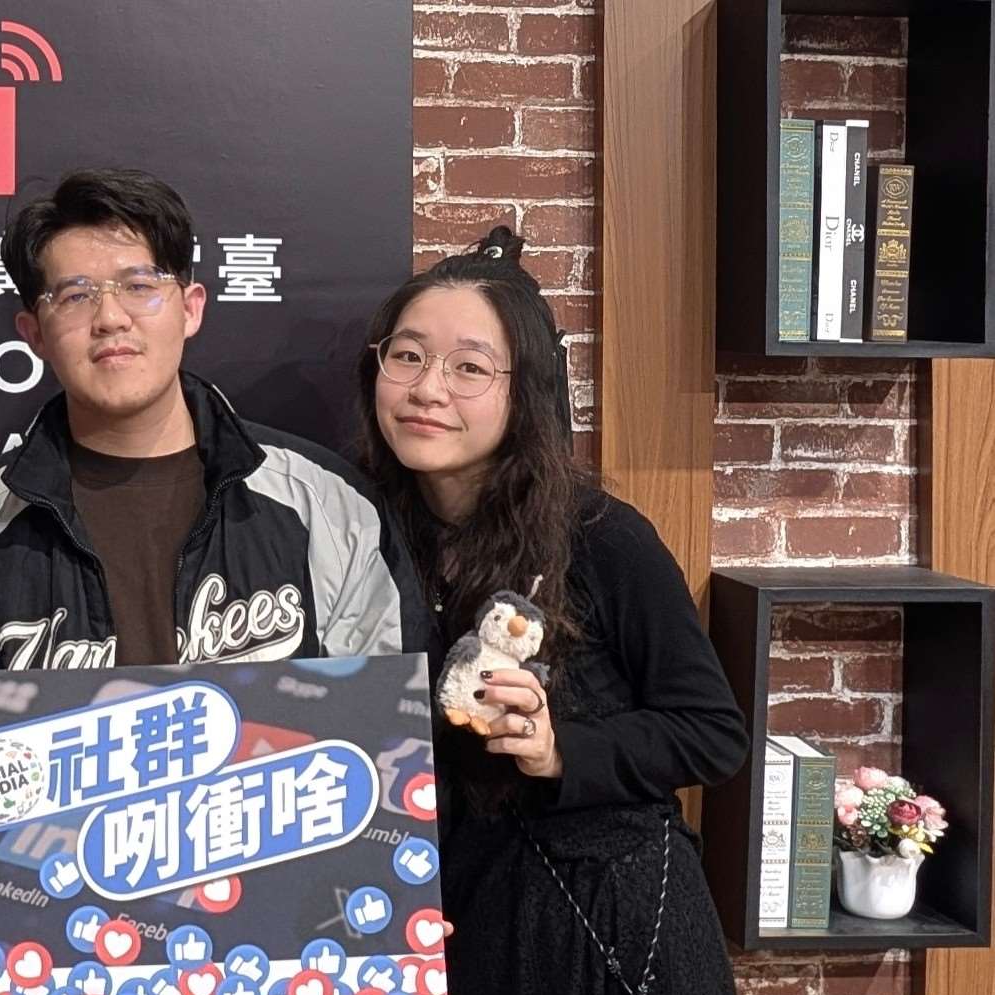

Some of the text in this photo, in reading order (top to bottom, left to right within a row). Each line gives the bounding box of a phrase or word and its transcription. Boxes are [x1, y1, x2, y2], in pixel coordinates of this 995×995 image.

[47, 692, 208, 806] 社群
[104, 752, 348, 888] 咧衝啥
